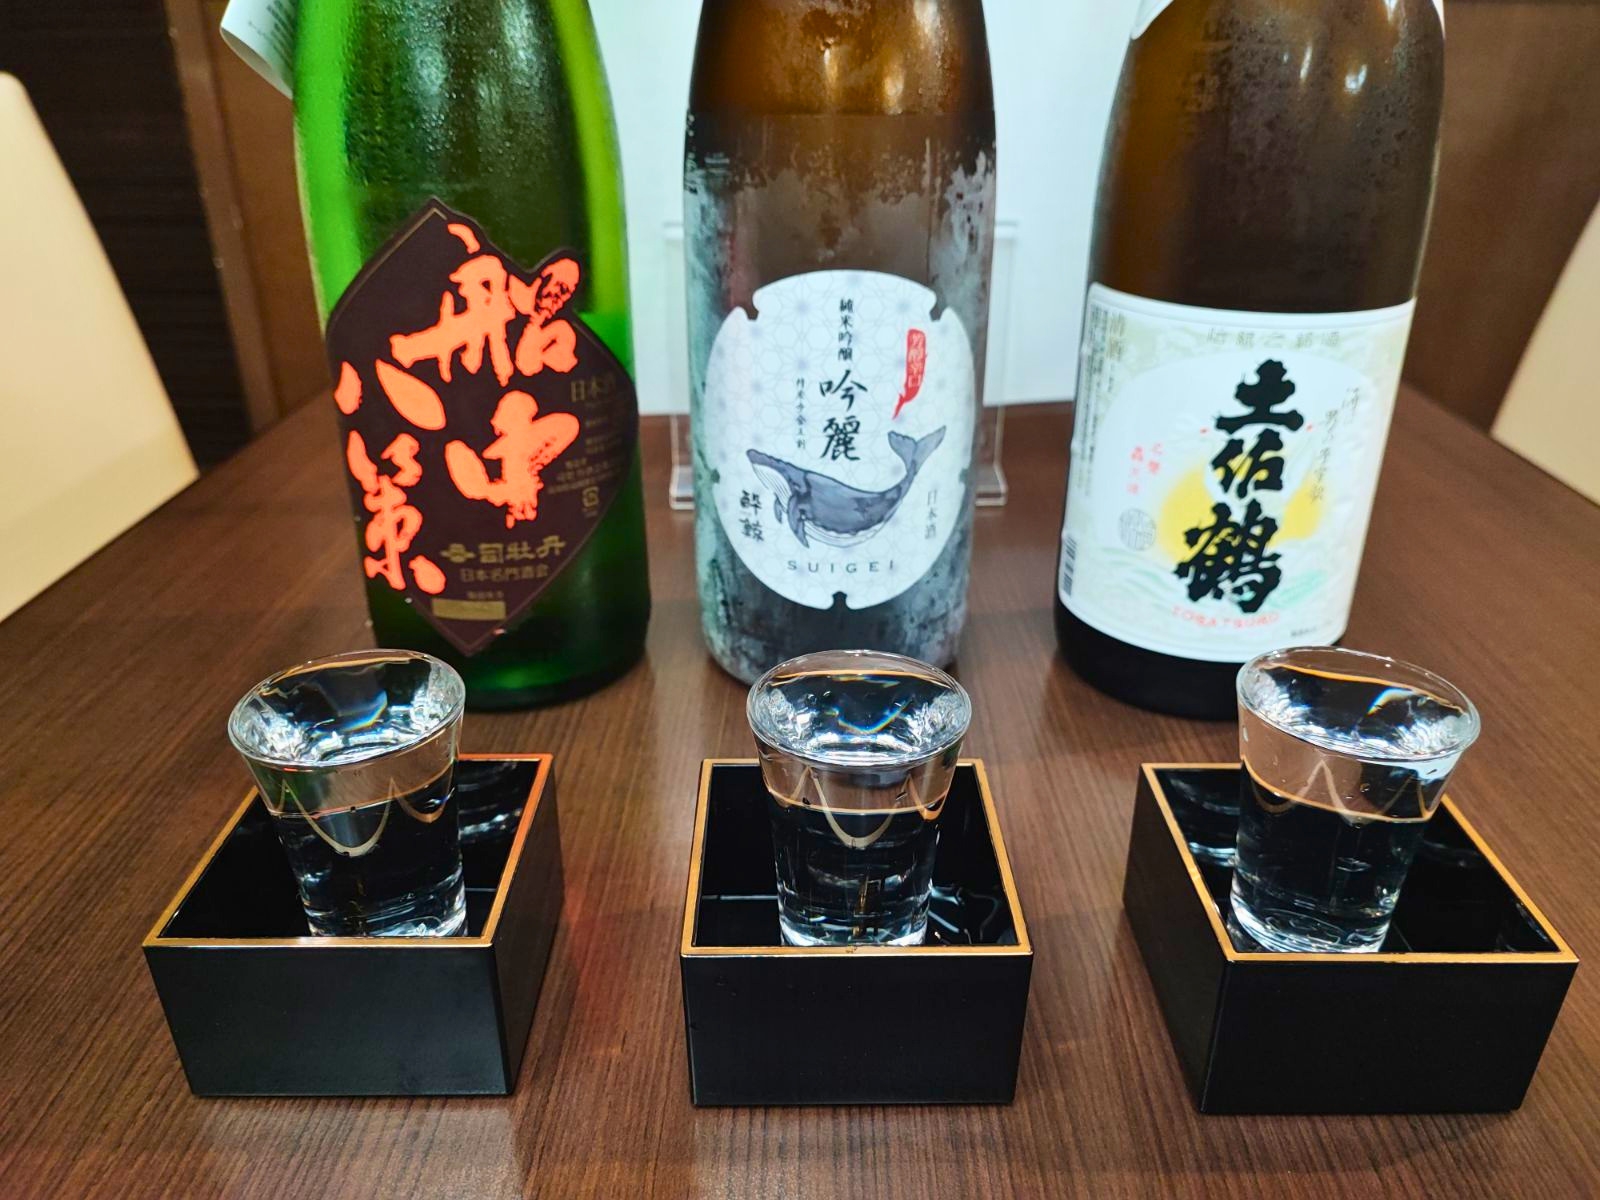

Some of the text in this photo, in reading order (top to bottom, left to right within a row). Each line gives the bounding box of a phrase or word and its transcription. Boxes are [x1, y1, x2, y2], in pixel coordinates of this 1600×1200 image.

[838, 299, 853, 361] 純米吟醸
[819, 369, 868, 461] 吟麗
[1174, 359, 1304, 613] 土佐鶴
[786, 559, 894, 574] SUIGEI
